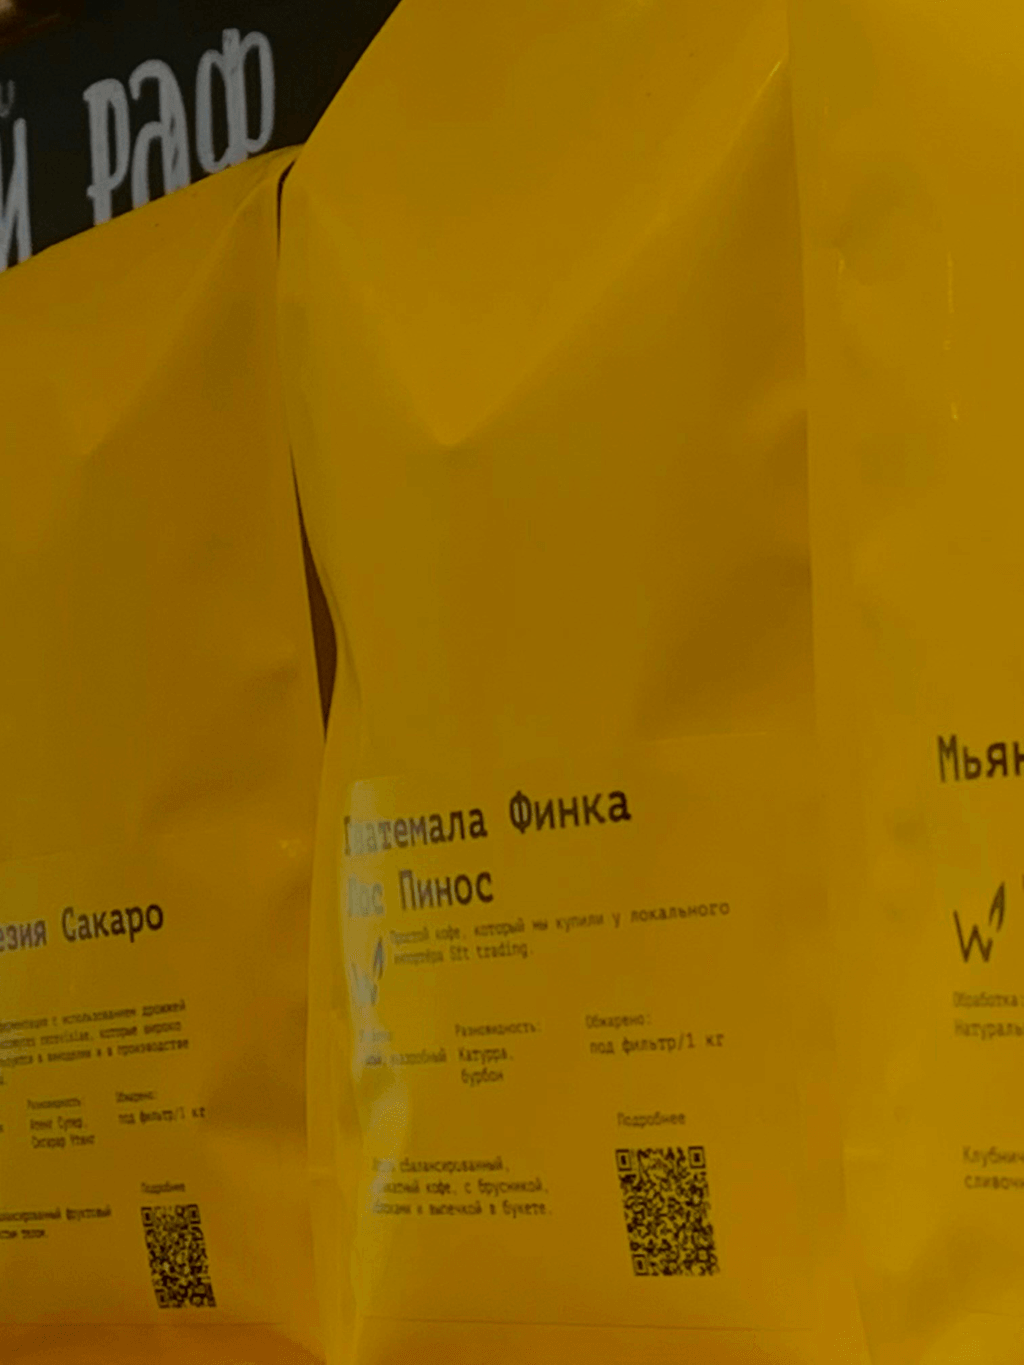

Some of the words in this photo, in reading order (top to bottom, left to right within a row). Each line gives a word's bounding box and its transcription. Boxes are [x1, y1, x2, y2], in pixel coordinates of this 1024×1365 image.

[509, 790, 632, 834] Финка
[399, 869, 494, 911] Пинос
[61, 904, 164, 944] Сакаро
[612, 911, 622, 929] у
[630, 902, 731, 924] локального
[590, 1039, 615, 1055] под
[705, 1033, 725, 1049] кг
